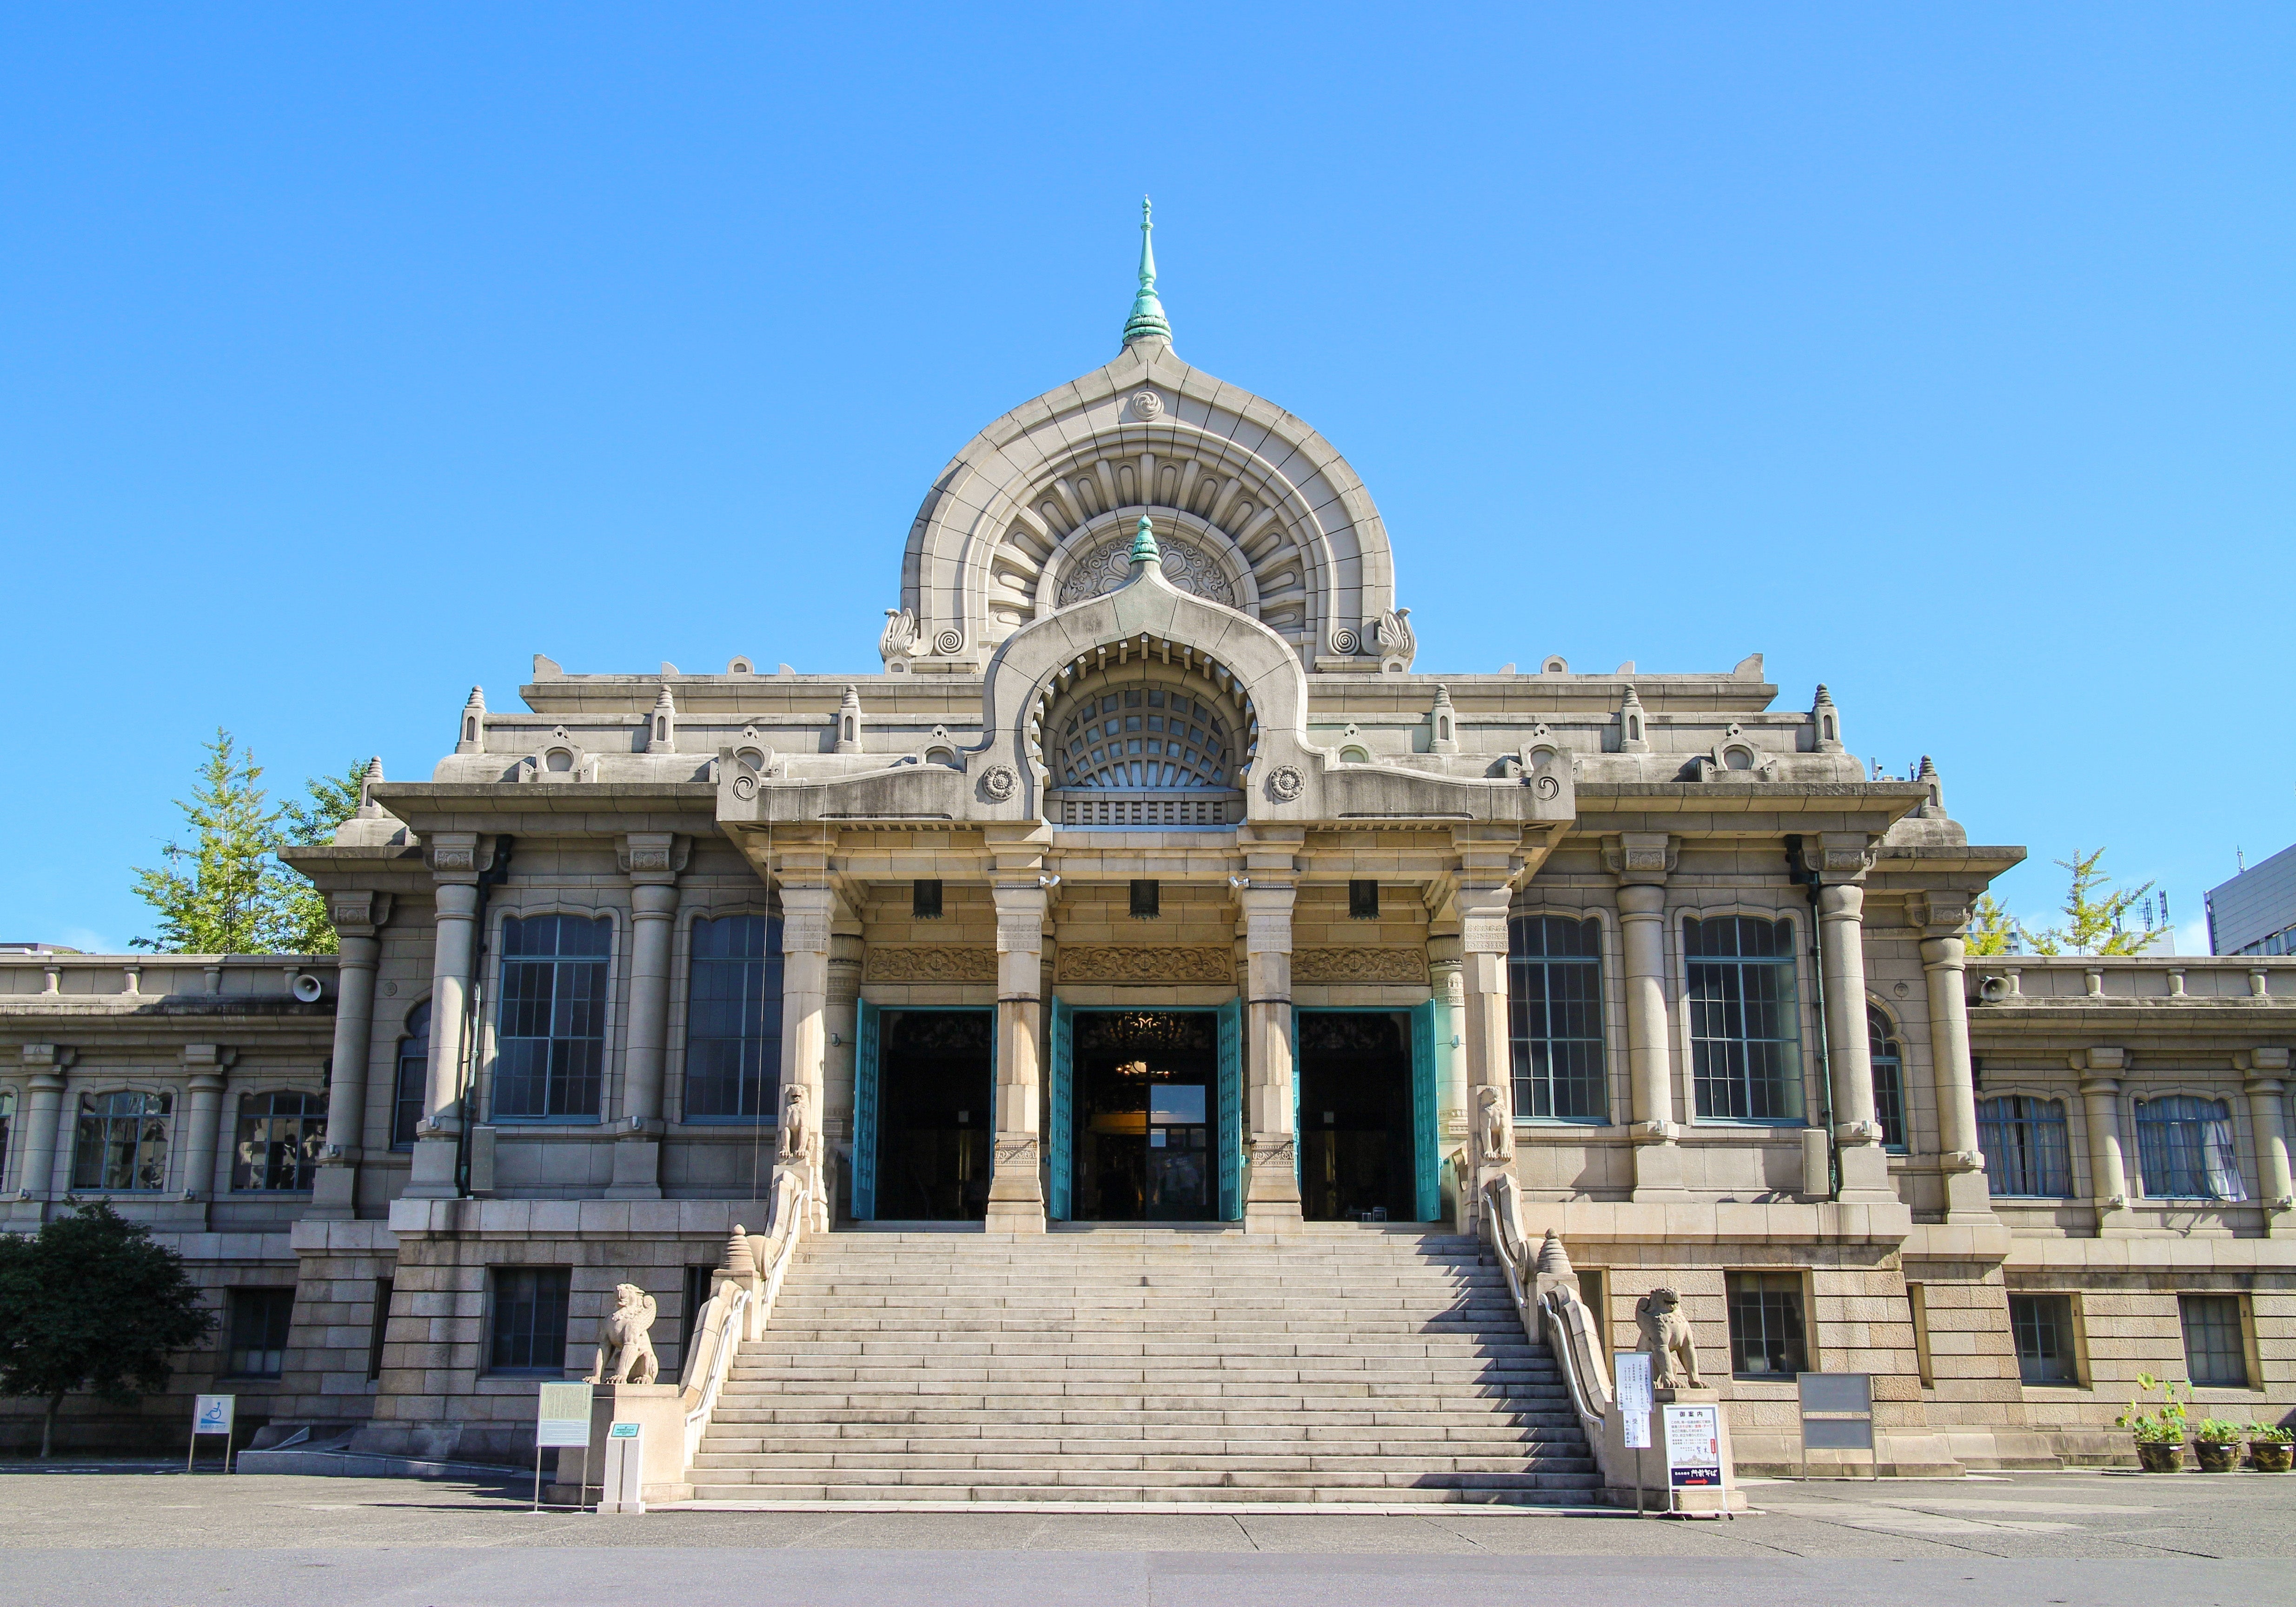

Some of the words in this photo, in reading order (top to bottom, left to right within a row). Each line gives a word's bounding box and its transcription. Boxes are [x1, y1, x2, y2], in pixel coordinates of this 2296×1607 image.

[1632, 1418, 1639, 1441] 受付
[1691, 1469, 1718, 1477] 門前そば
